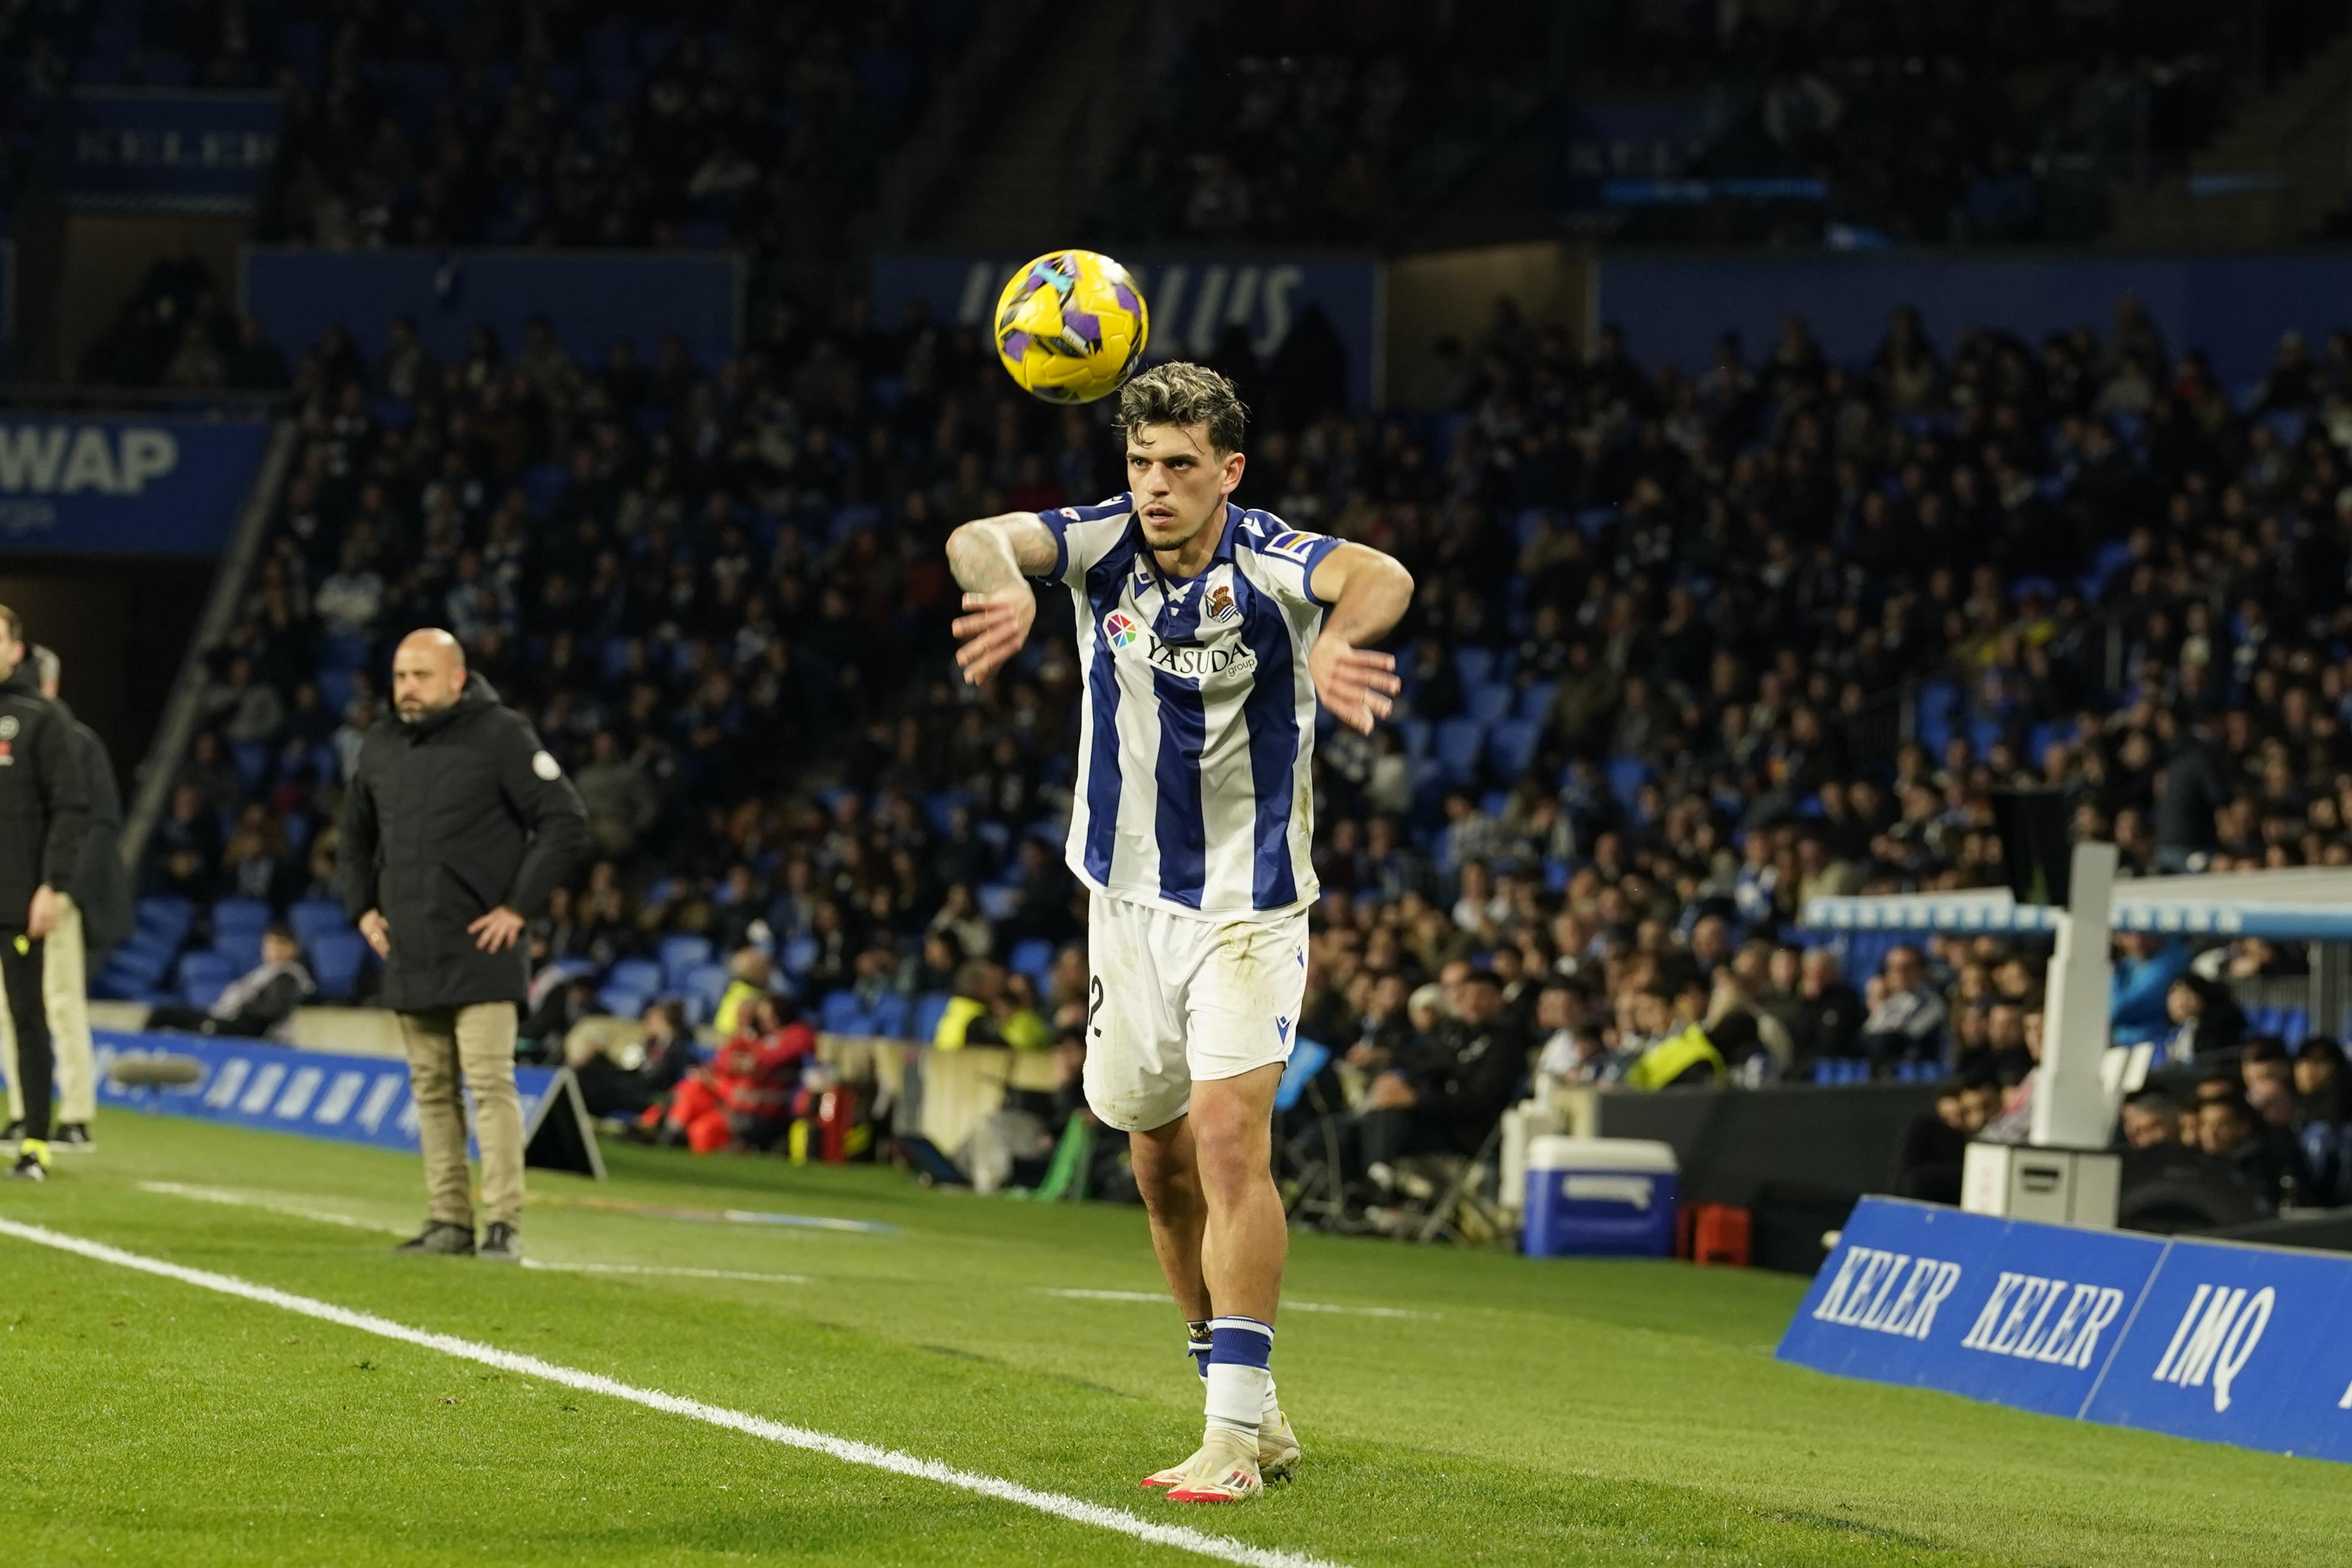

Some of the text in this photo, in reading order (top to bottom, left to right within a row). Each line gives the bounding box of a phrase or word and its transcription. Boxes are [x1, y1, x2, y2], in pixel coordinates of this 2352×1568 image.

[1146, 634, 1250, 674] YASUDA
[1228, 659, 1255, 676] group
[1812, 1245, 2276, 1413] KELER KELER IMQ
